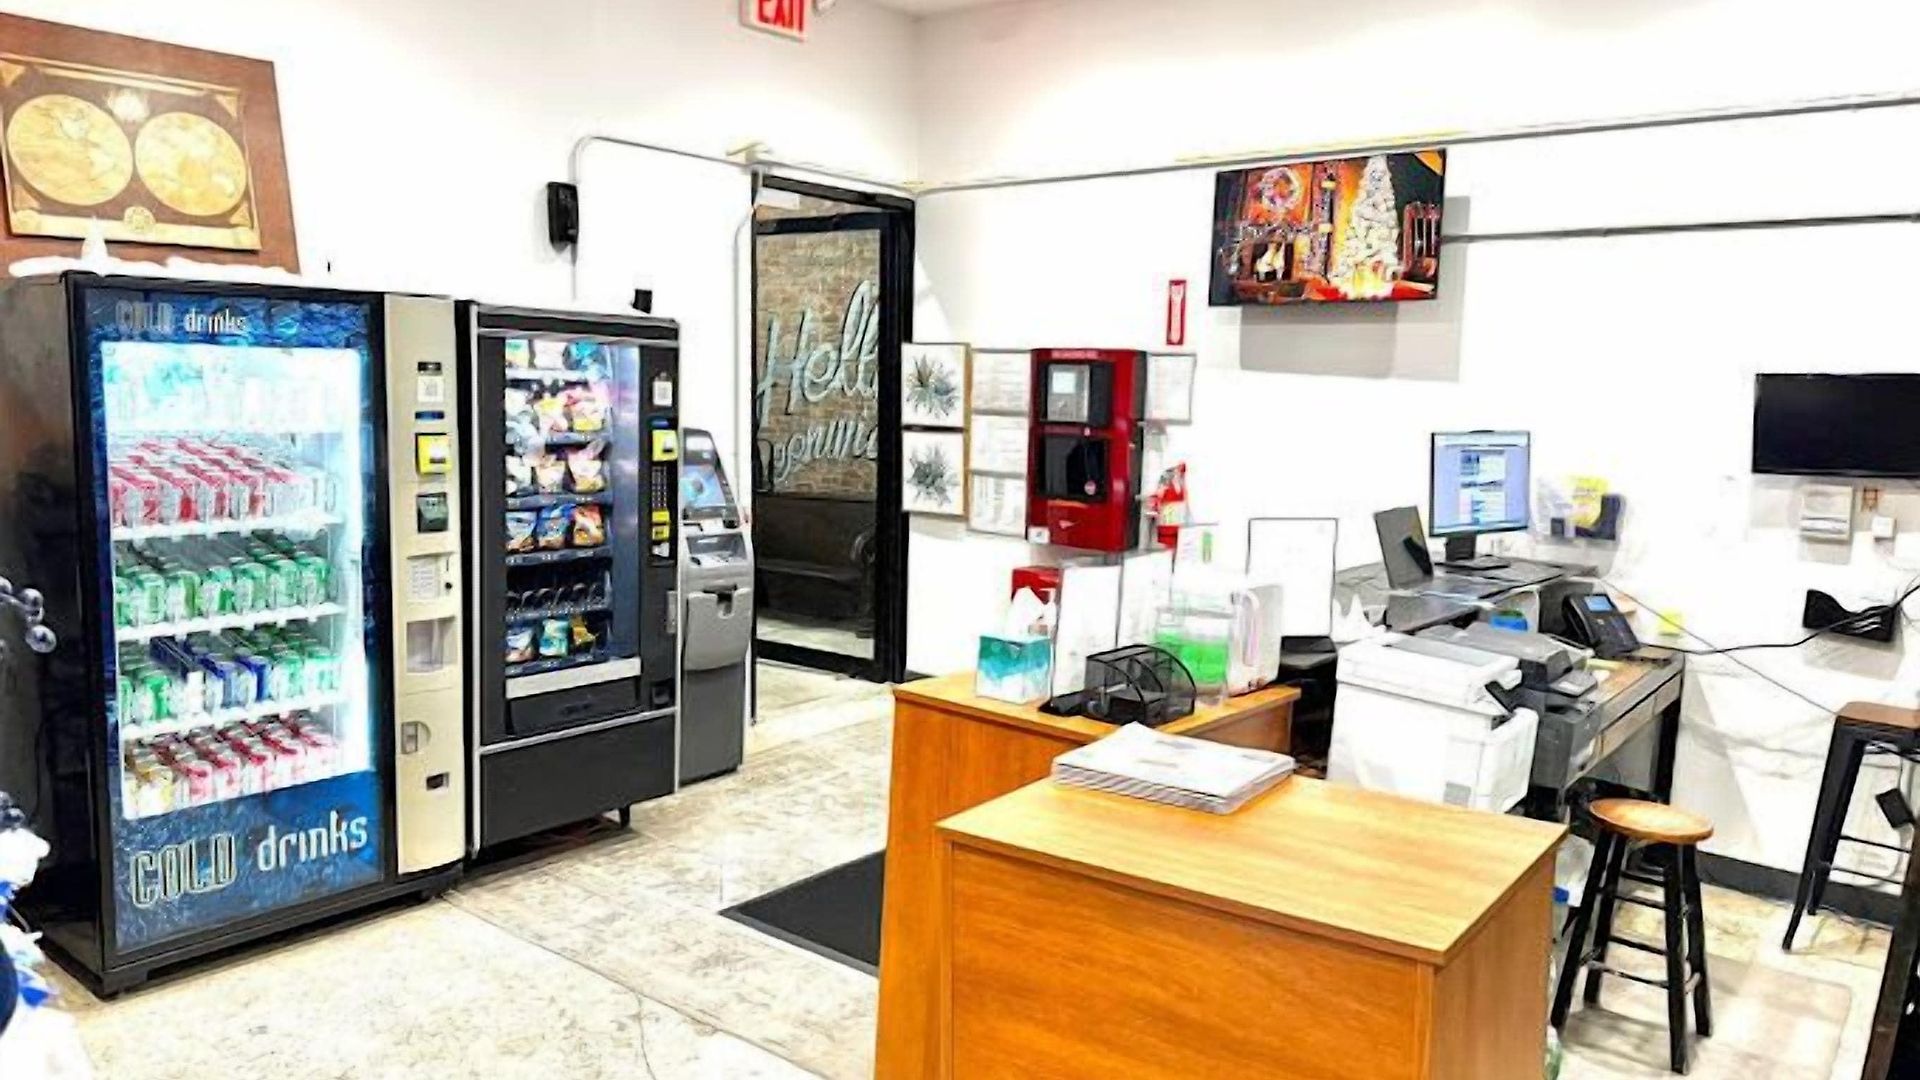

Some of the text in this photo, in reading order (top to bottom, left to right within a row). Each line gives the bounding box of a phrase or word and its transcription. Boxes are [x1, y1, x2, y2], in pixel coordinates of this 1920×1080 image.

[184, 307, 247, 334] drinks
[130, 810, 368, 909] COLD drinks
